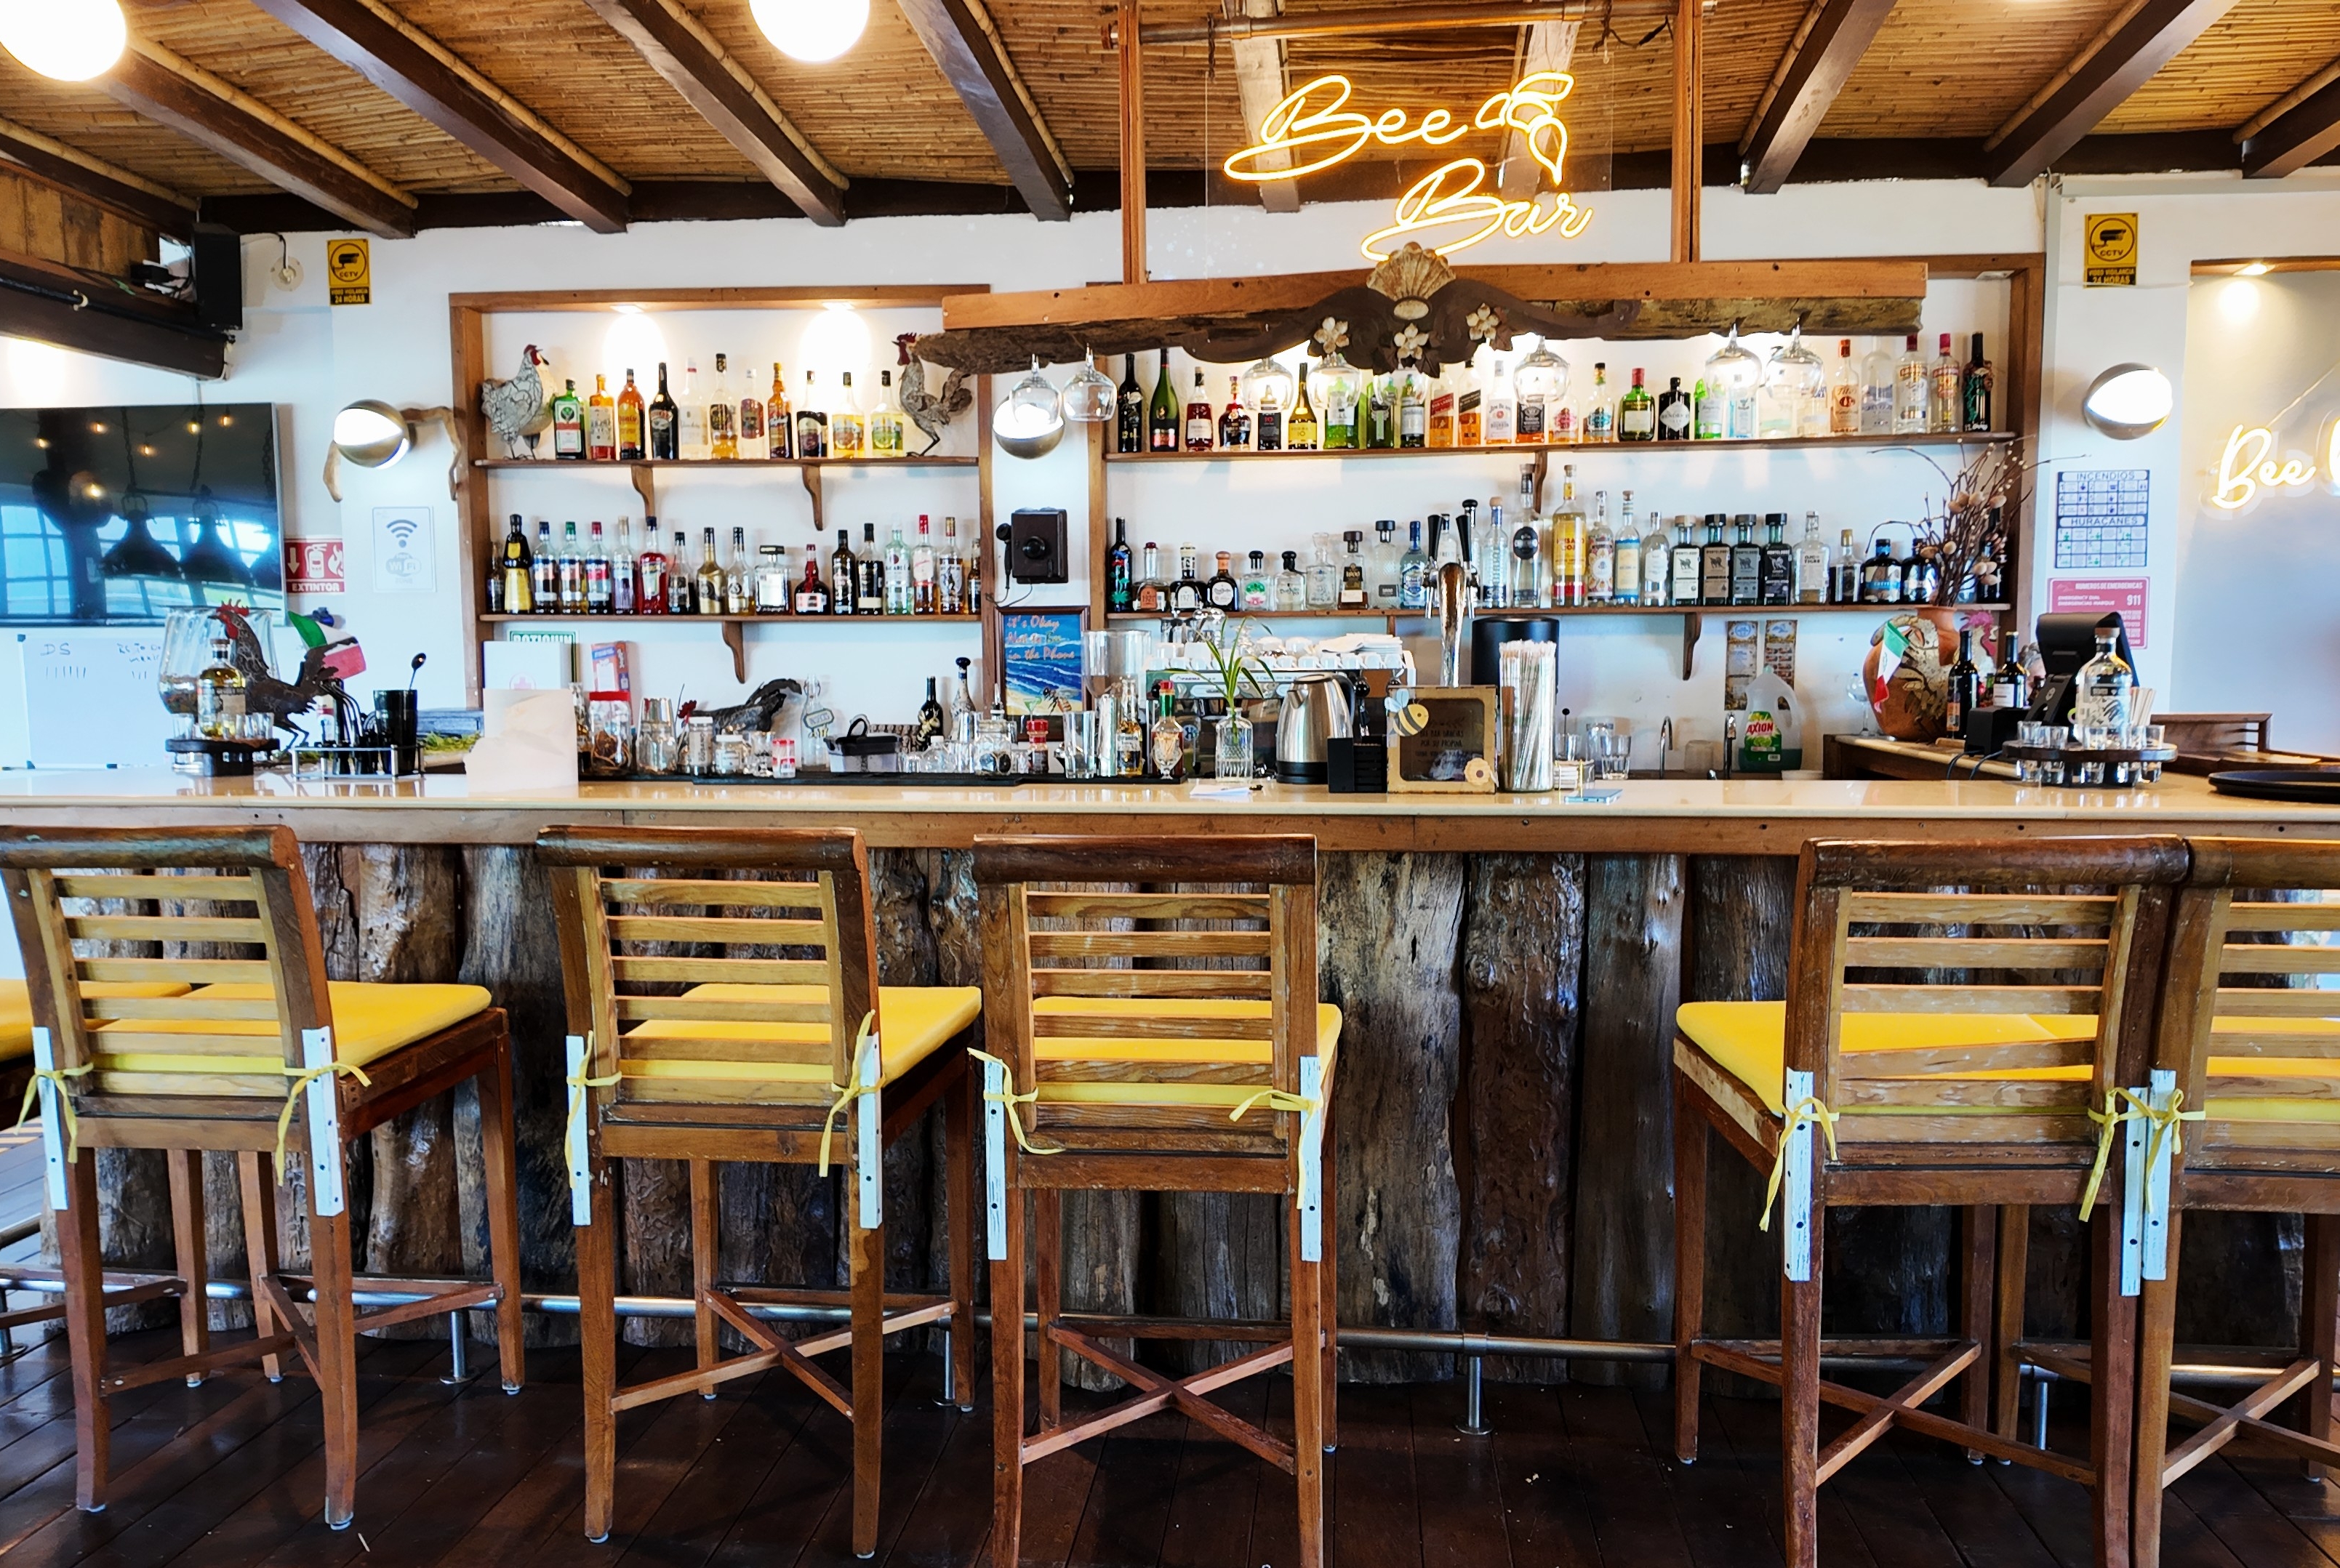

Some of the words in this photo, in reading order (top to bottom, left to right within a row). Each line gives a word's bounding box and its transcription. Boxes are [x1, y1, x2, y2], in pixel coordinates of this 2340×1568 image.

[1223, 74, 1469, 182] Bee
[1361, 158, 1594, 262] Bar
[2211, 424, 2317, 510] Bee
[2076, 471, 2135, 481] INCENDIOS
[2071, 517, 2138, 526] HURACANES
[292, 583, 340, 592] EXTINTOR
[2127, 594, 2141, 606] 911
[1747, 722, 1774, 736] AXION
